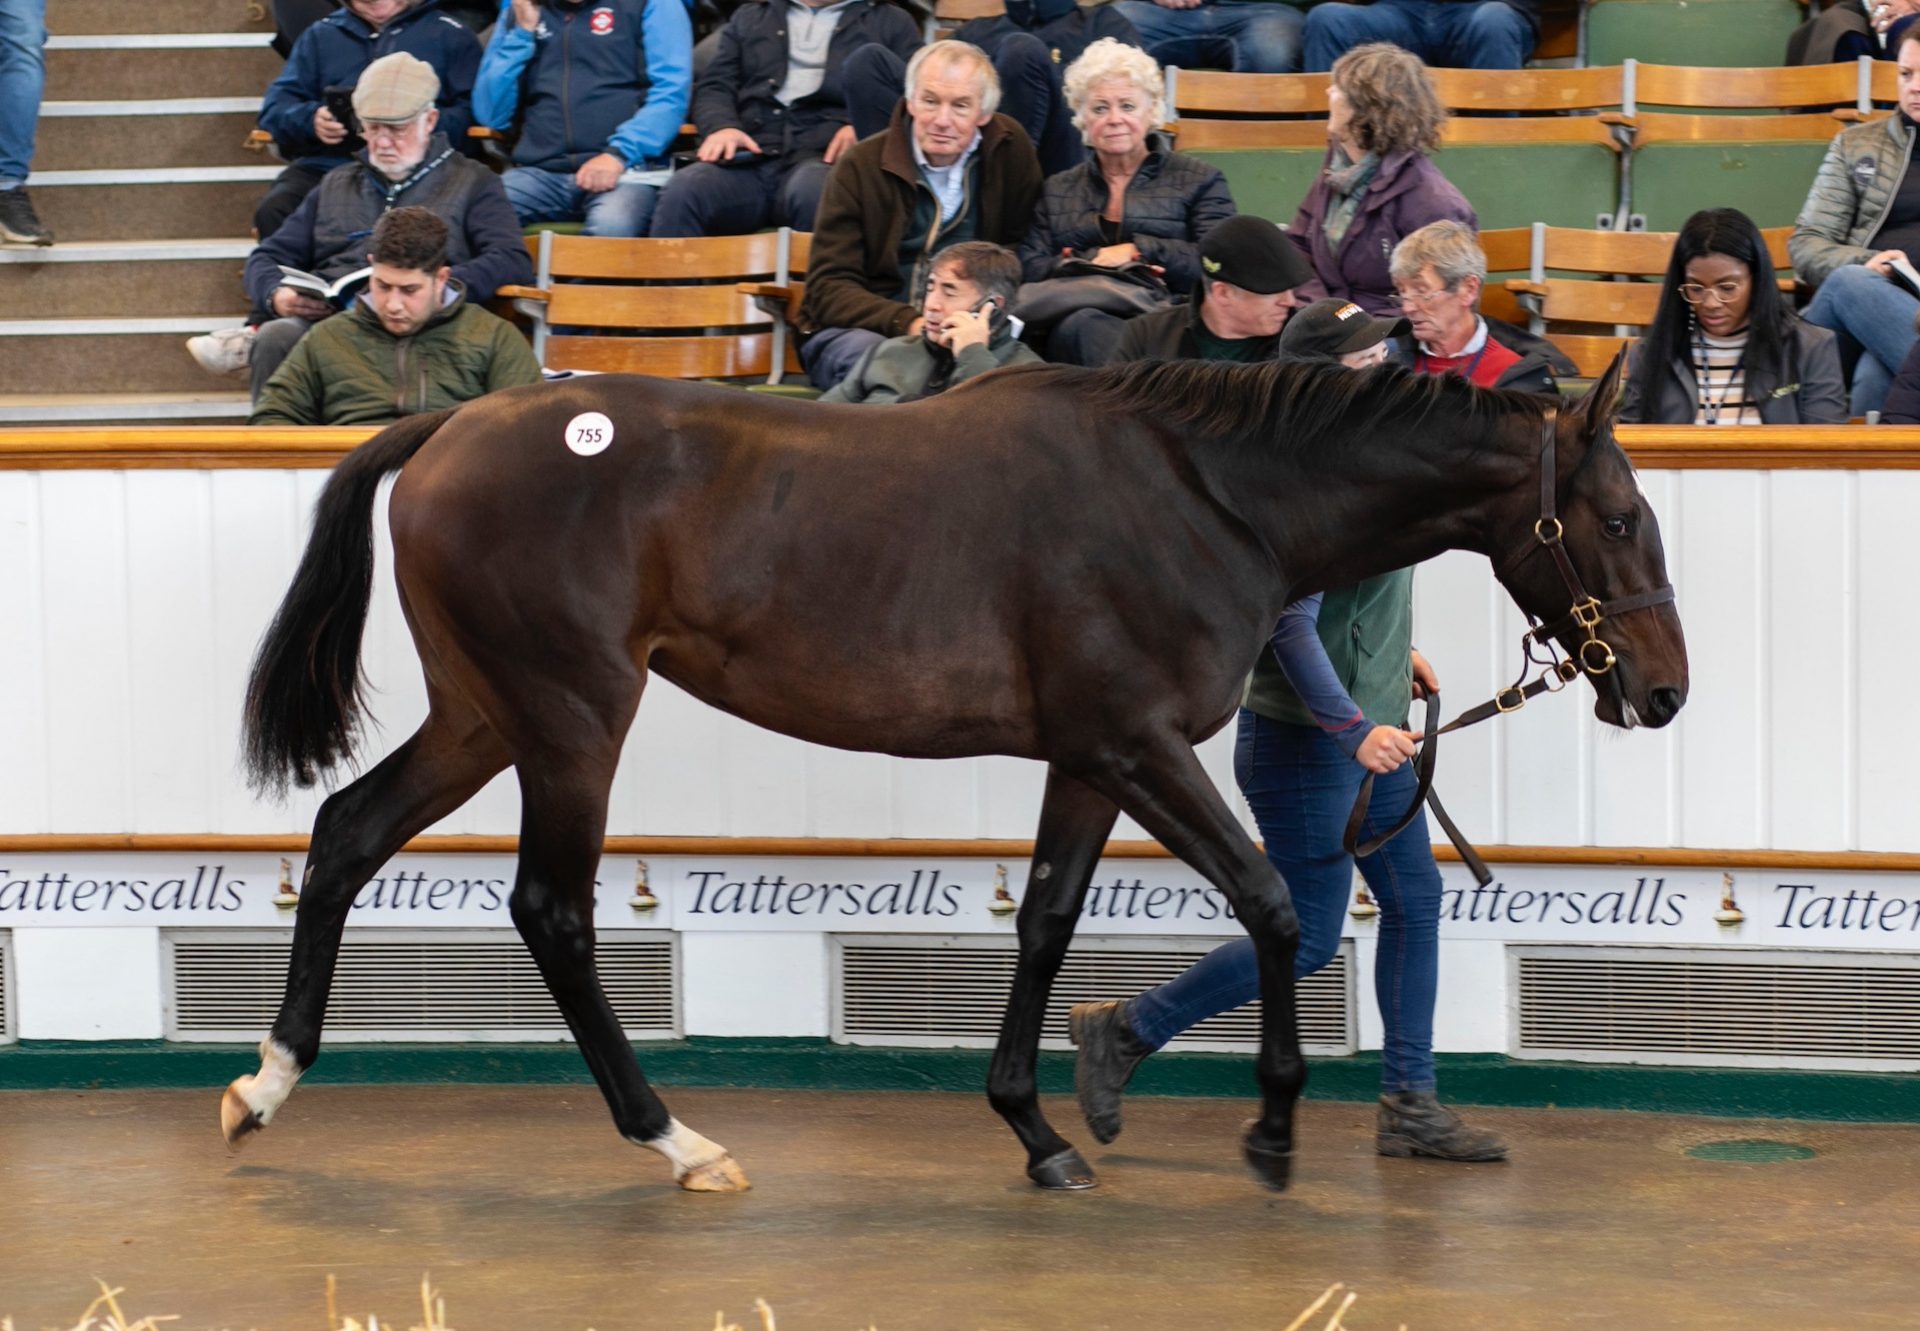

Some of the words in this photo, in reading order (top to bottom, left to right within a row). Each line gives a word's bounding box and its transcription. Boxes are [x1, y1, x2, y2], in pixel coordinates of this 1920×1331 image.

[577, 428, 603, 443] 755
[0, 865, 246, 912] attersalls
[686, 869, 963, 917] Tattersalls
[1440, 877, 1687, 926] attersalls
